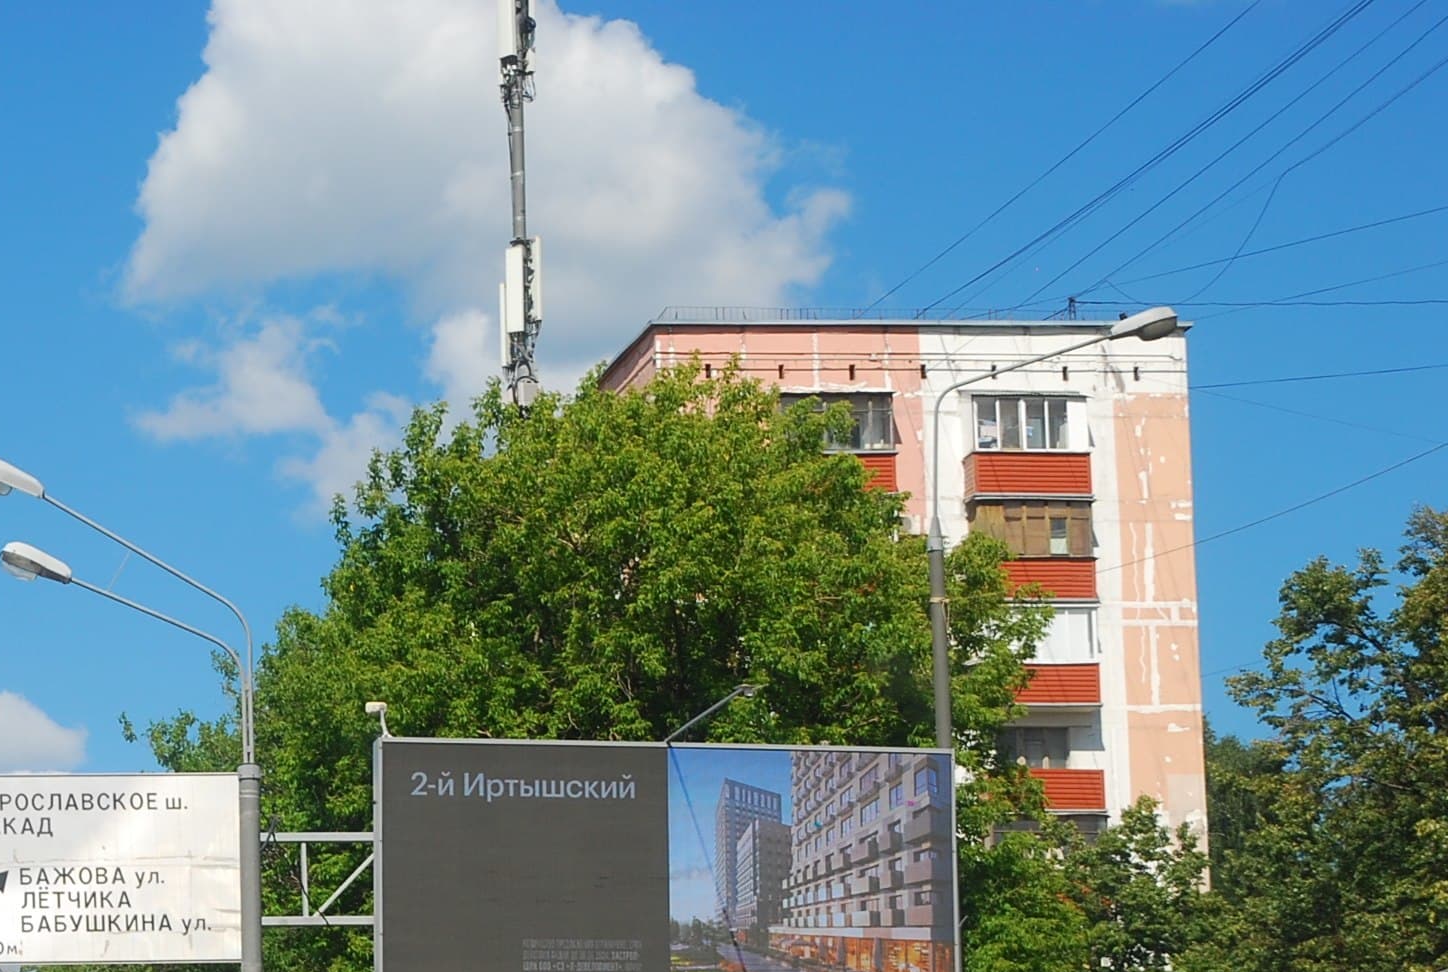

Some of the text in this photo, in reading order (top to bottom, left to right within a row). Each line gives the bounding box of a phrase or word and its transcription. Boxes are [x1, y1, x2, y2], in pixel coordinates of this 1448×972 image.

[411, 771, 635, 802] 2-й Иртышский
[165, 797, 188, 810] ш.
[19, 867, 165, 889] БАЖОВА ул.
[21, 886, 132, 909] ЛЁТЧИКА
[21, 914, 212, 936] БАБУШКИНА ул.
